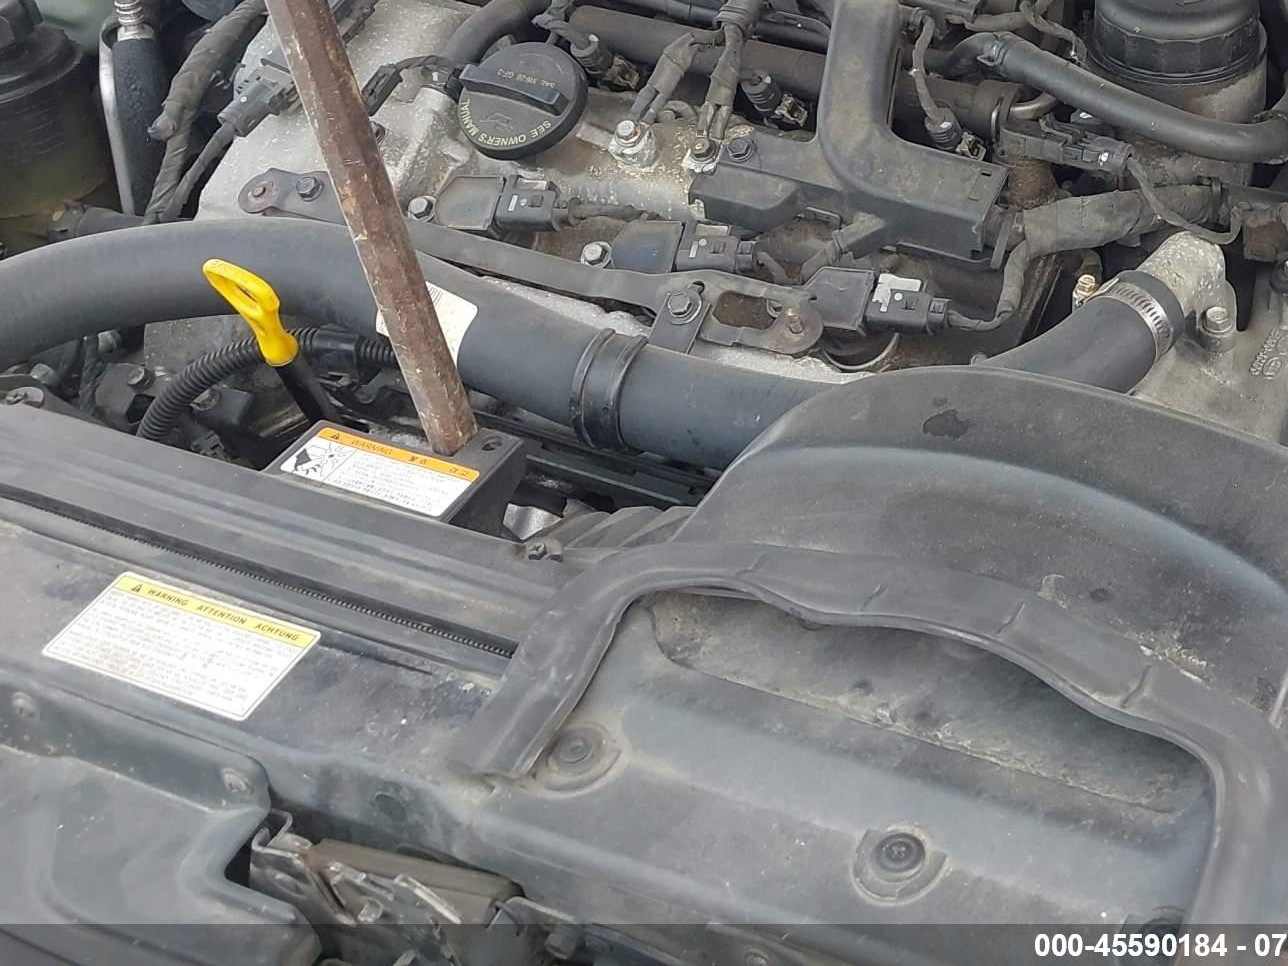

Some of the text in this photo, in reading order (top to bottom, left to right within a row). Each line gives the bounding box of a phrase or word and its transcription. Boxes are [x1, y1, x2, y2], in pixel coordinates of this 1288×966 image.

[460, 98, 552, 147] SEE OWNER'S MANUAL
[350, 438, 394, 456] WARNING
[146, 588, 300, 642] WARNING ATTENTION ACHTUNG
